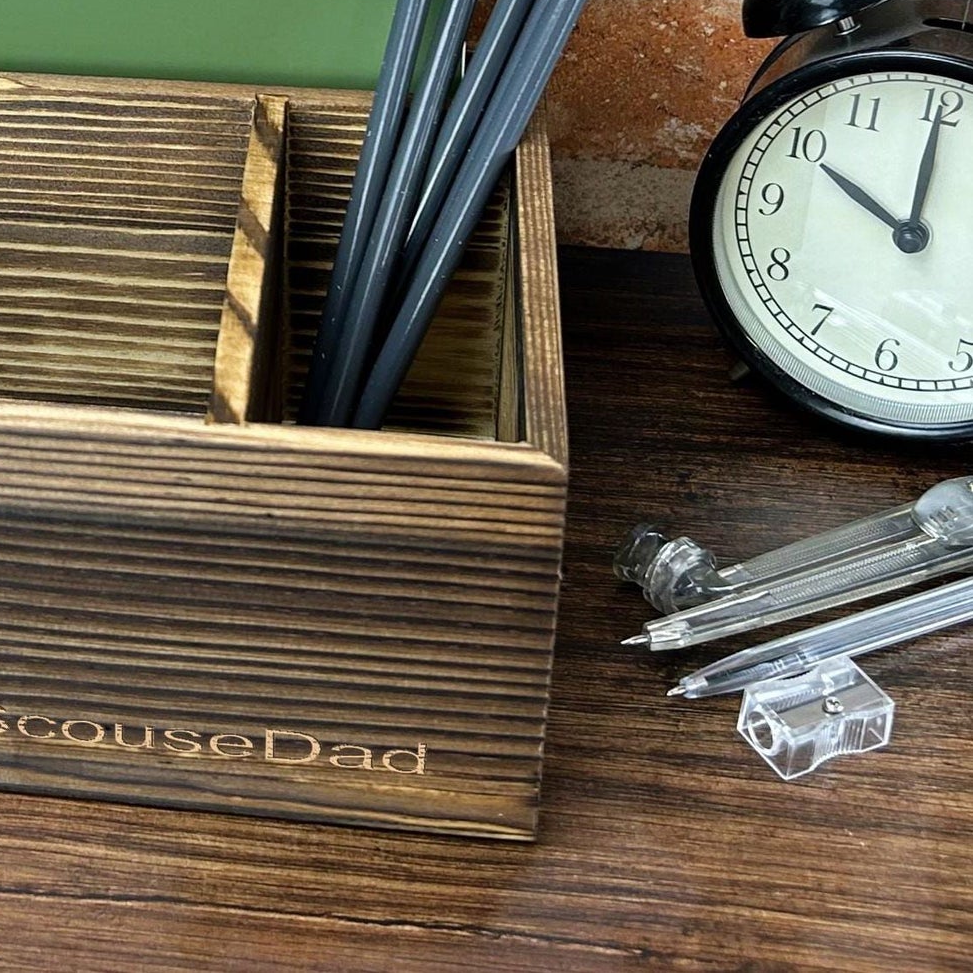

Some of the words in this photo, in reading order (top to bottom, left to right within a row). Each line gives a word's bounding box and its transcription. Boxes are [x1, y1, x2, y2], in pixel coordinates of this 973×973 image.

[845, 93, 881, 132] 11
[920, 88, 964, 127] 12
[786, 127, 827, 163] 10
[758, 182, 784, 216] 9
[766, 247, 791, 281] 8
[811, 303, 834, 336] 7
[874, 338, 901, 372] 6
[948, 339, 973, 373] 5
